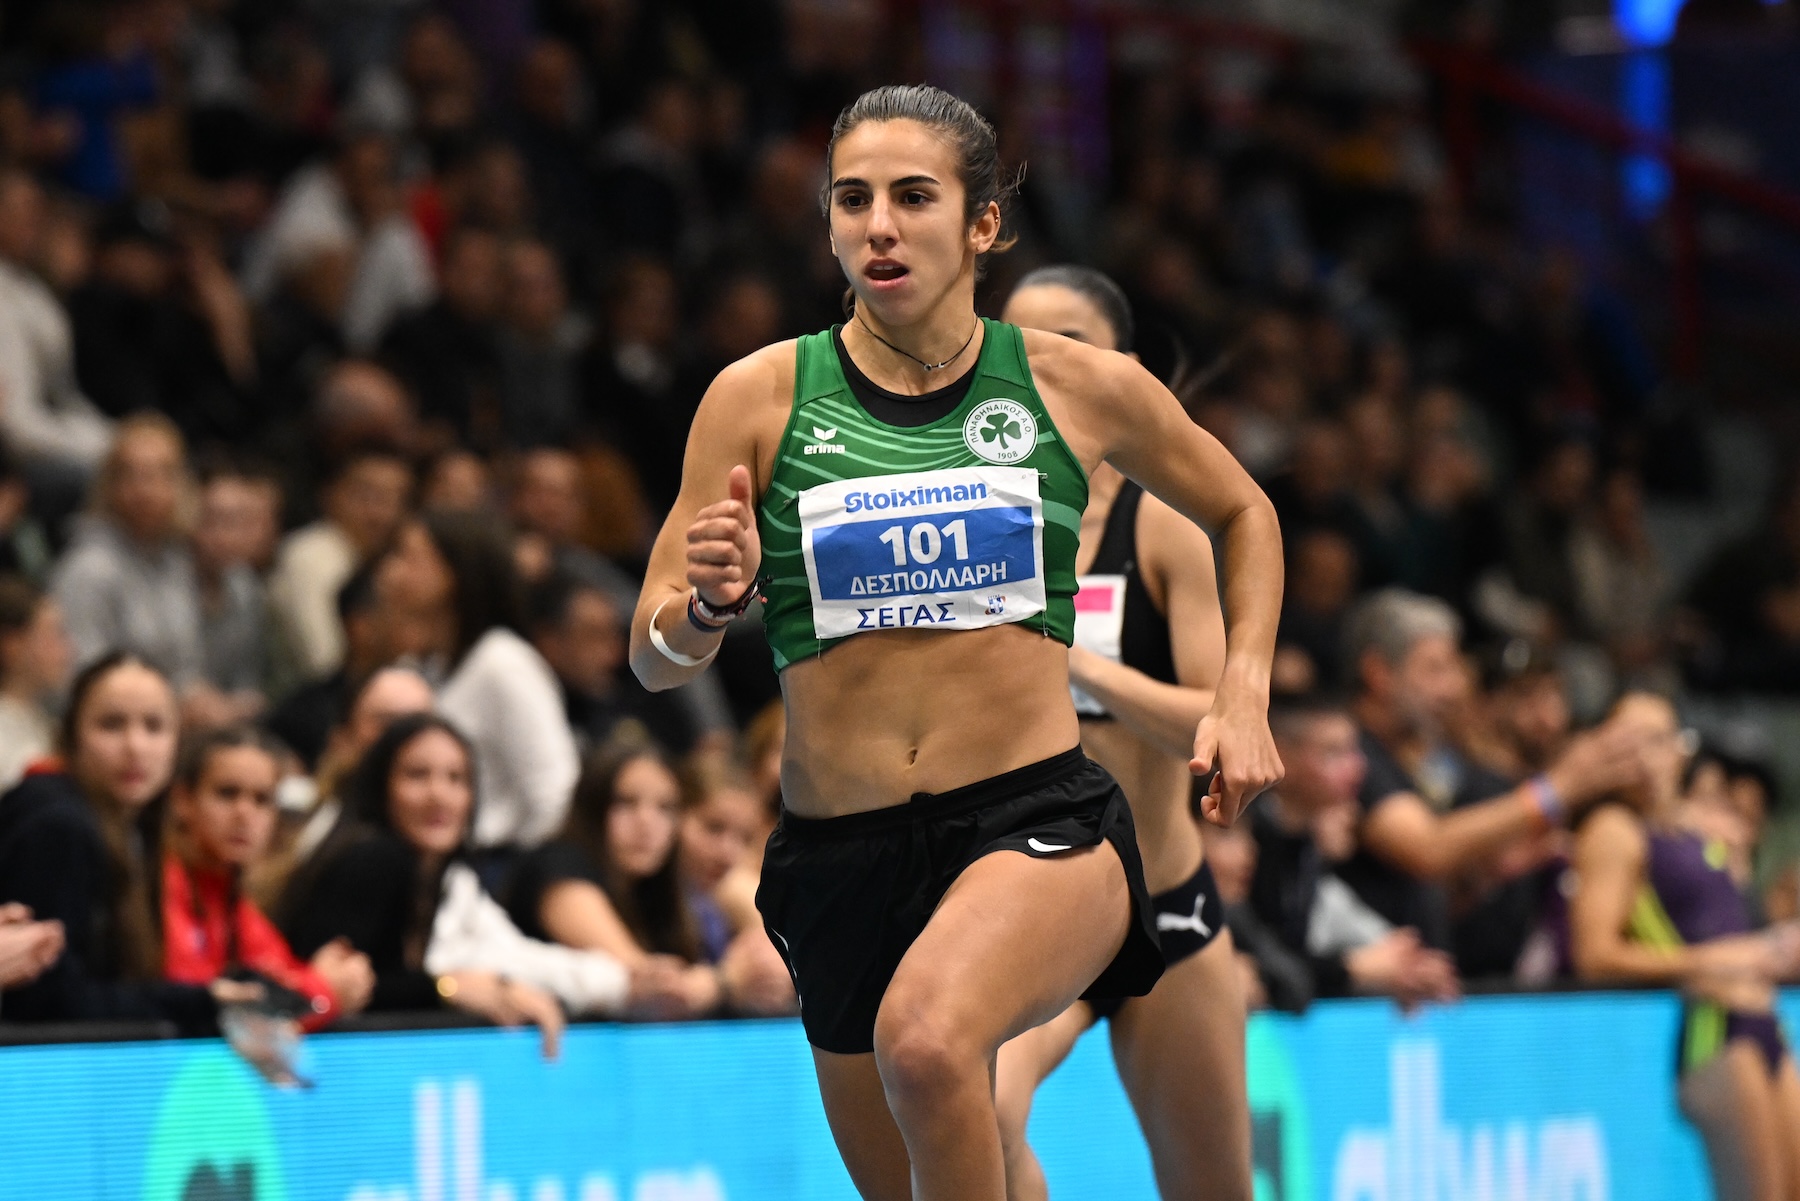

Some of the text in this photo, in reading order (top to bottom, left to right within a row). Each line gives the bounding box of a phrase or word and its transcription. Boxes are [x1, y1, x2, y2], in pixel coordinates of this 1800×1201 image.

[969, 402, 1023, 444] ΠΑΝΑΘΗΝΑΪΚΟΣ
[803, 442, 846, 455] erima
[997, 450, 1018, 460] 1908
[843, 482, 988, 513] Stoiximan
[879, 518, 969, 567] 101
[850, 561, 1008, 596] ΔΕΣΠΟΛΛΑΡΗ
[856, 602, 956, 629] ΣΕΓΑΣ
